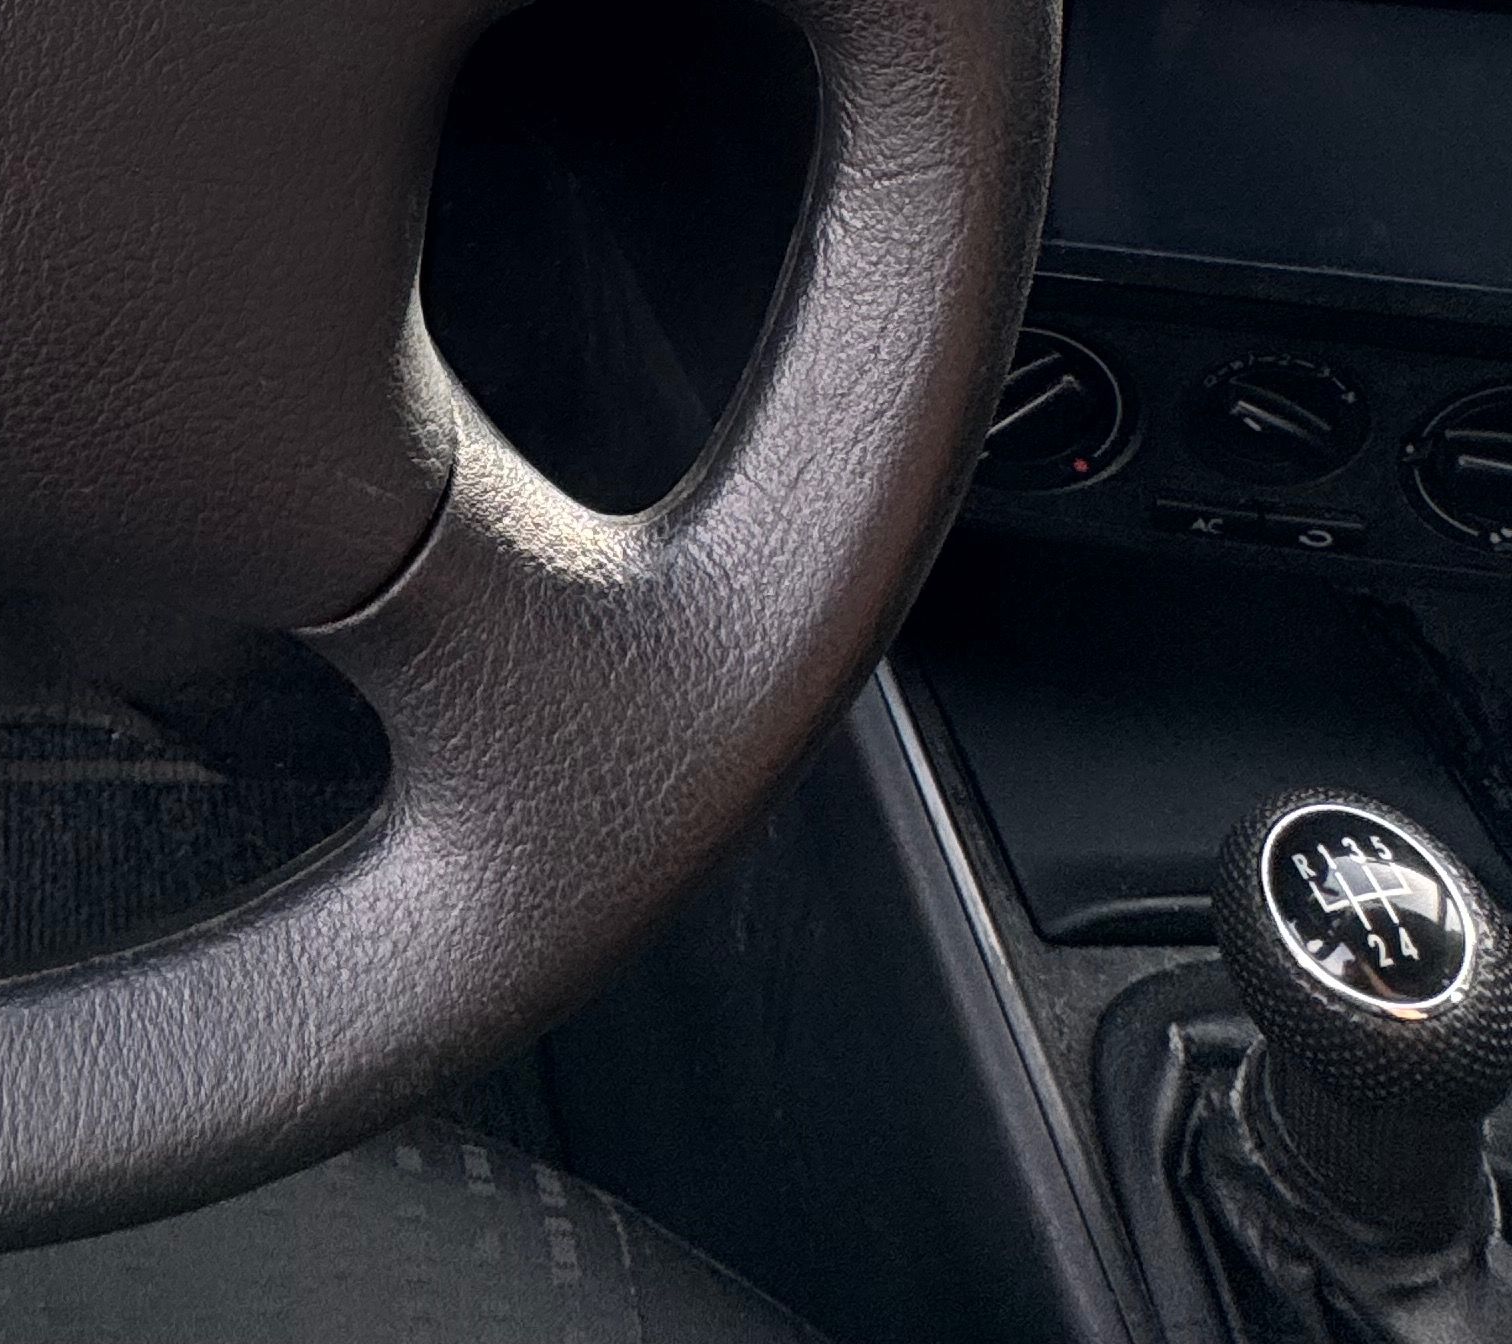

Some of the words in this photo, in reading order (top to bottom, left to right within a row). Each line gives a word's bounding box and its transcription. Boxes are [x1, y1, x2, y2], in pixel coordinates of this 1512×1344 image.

[1191, 517, 1224, 535] AC
[1291, 853, 1316, 881] R
[1317, 843, 1337, 869] 1
[1341, 836, 1367, 863] 3
[1369, 835, 1393, 860] 5
[1367, 934, 1395, 968] 2
[1399, 926, 1420, 961] 4
